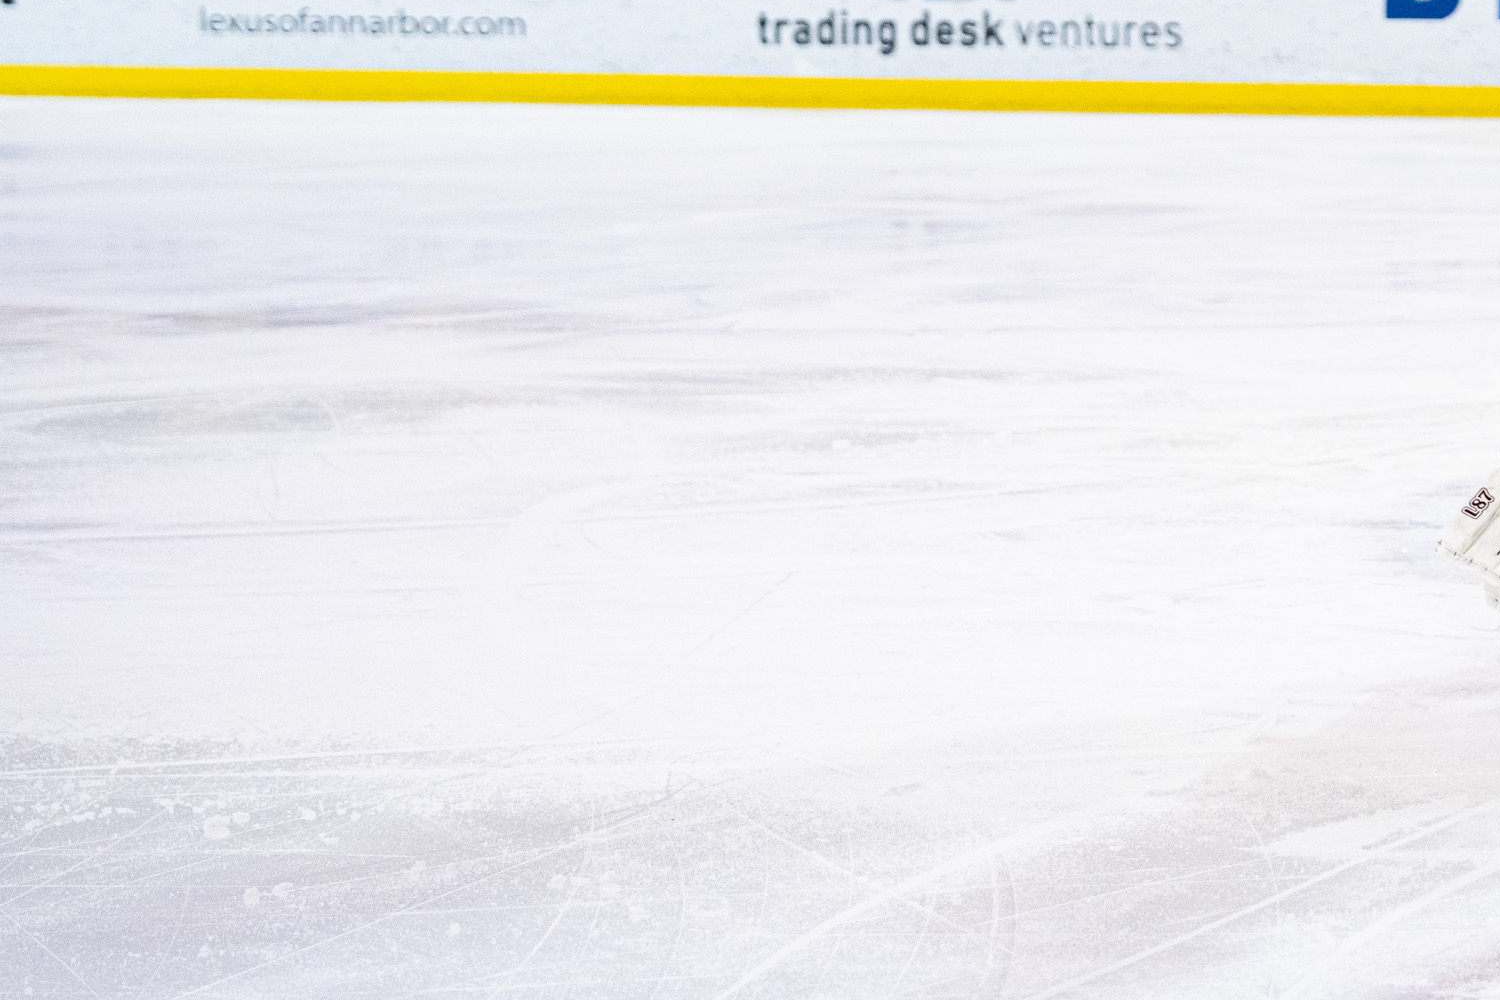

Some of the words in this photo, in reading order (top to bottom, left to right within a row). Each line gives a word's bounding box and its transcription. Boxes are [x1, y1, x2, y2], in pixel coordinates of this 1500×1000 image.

[200, 5, 526, 37] lexusofannarbor.com
[758, 10, 896, 53] trading
[911, 9, 1003, 46] desk
[1015, 13, 1184, 47] ventures
[1462, 487, 1495, 520] L87
